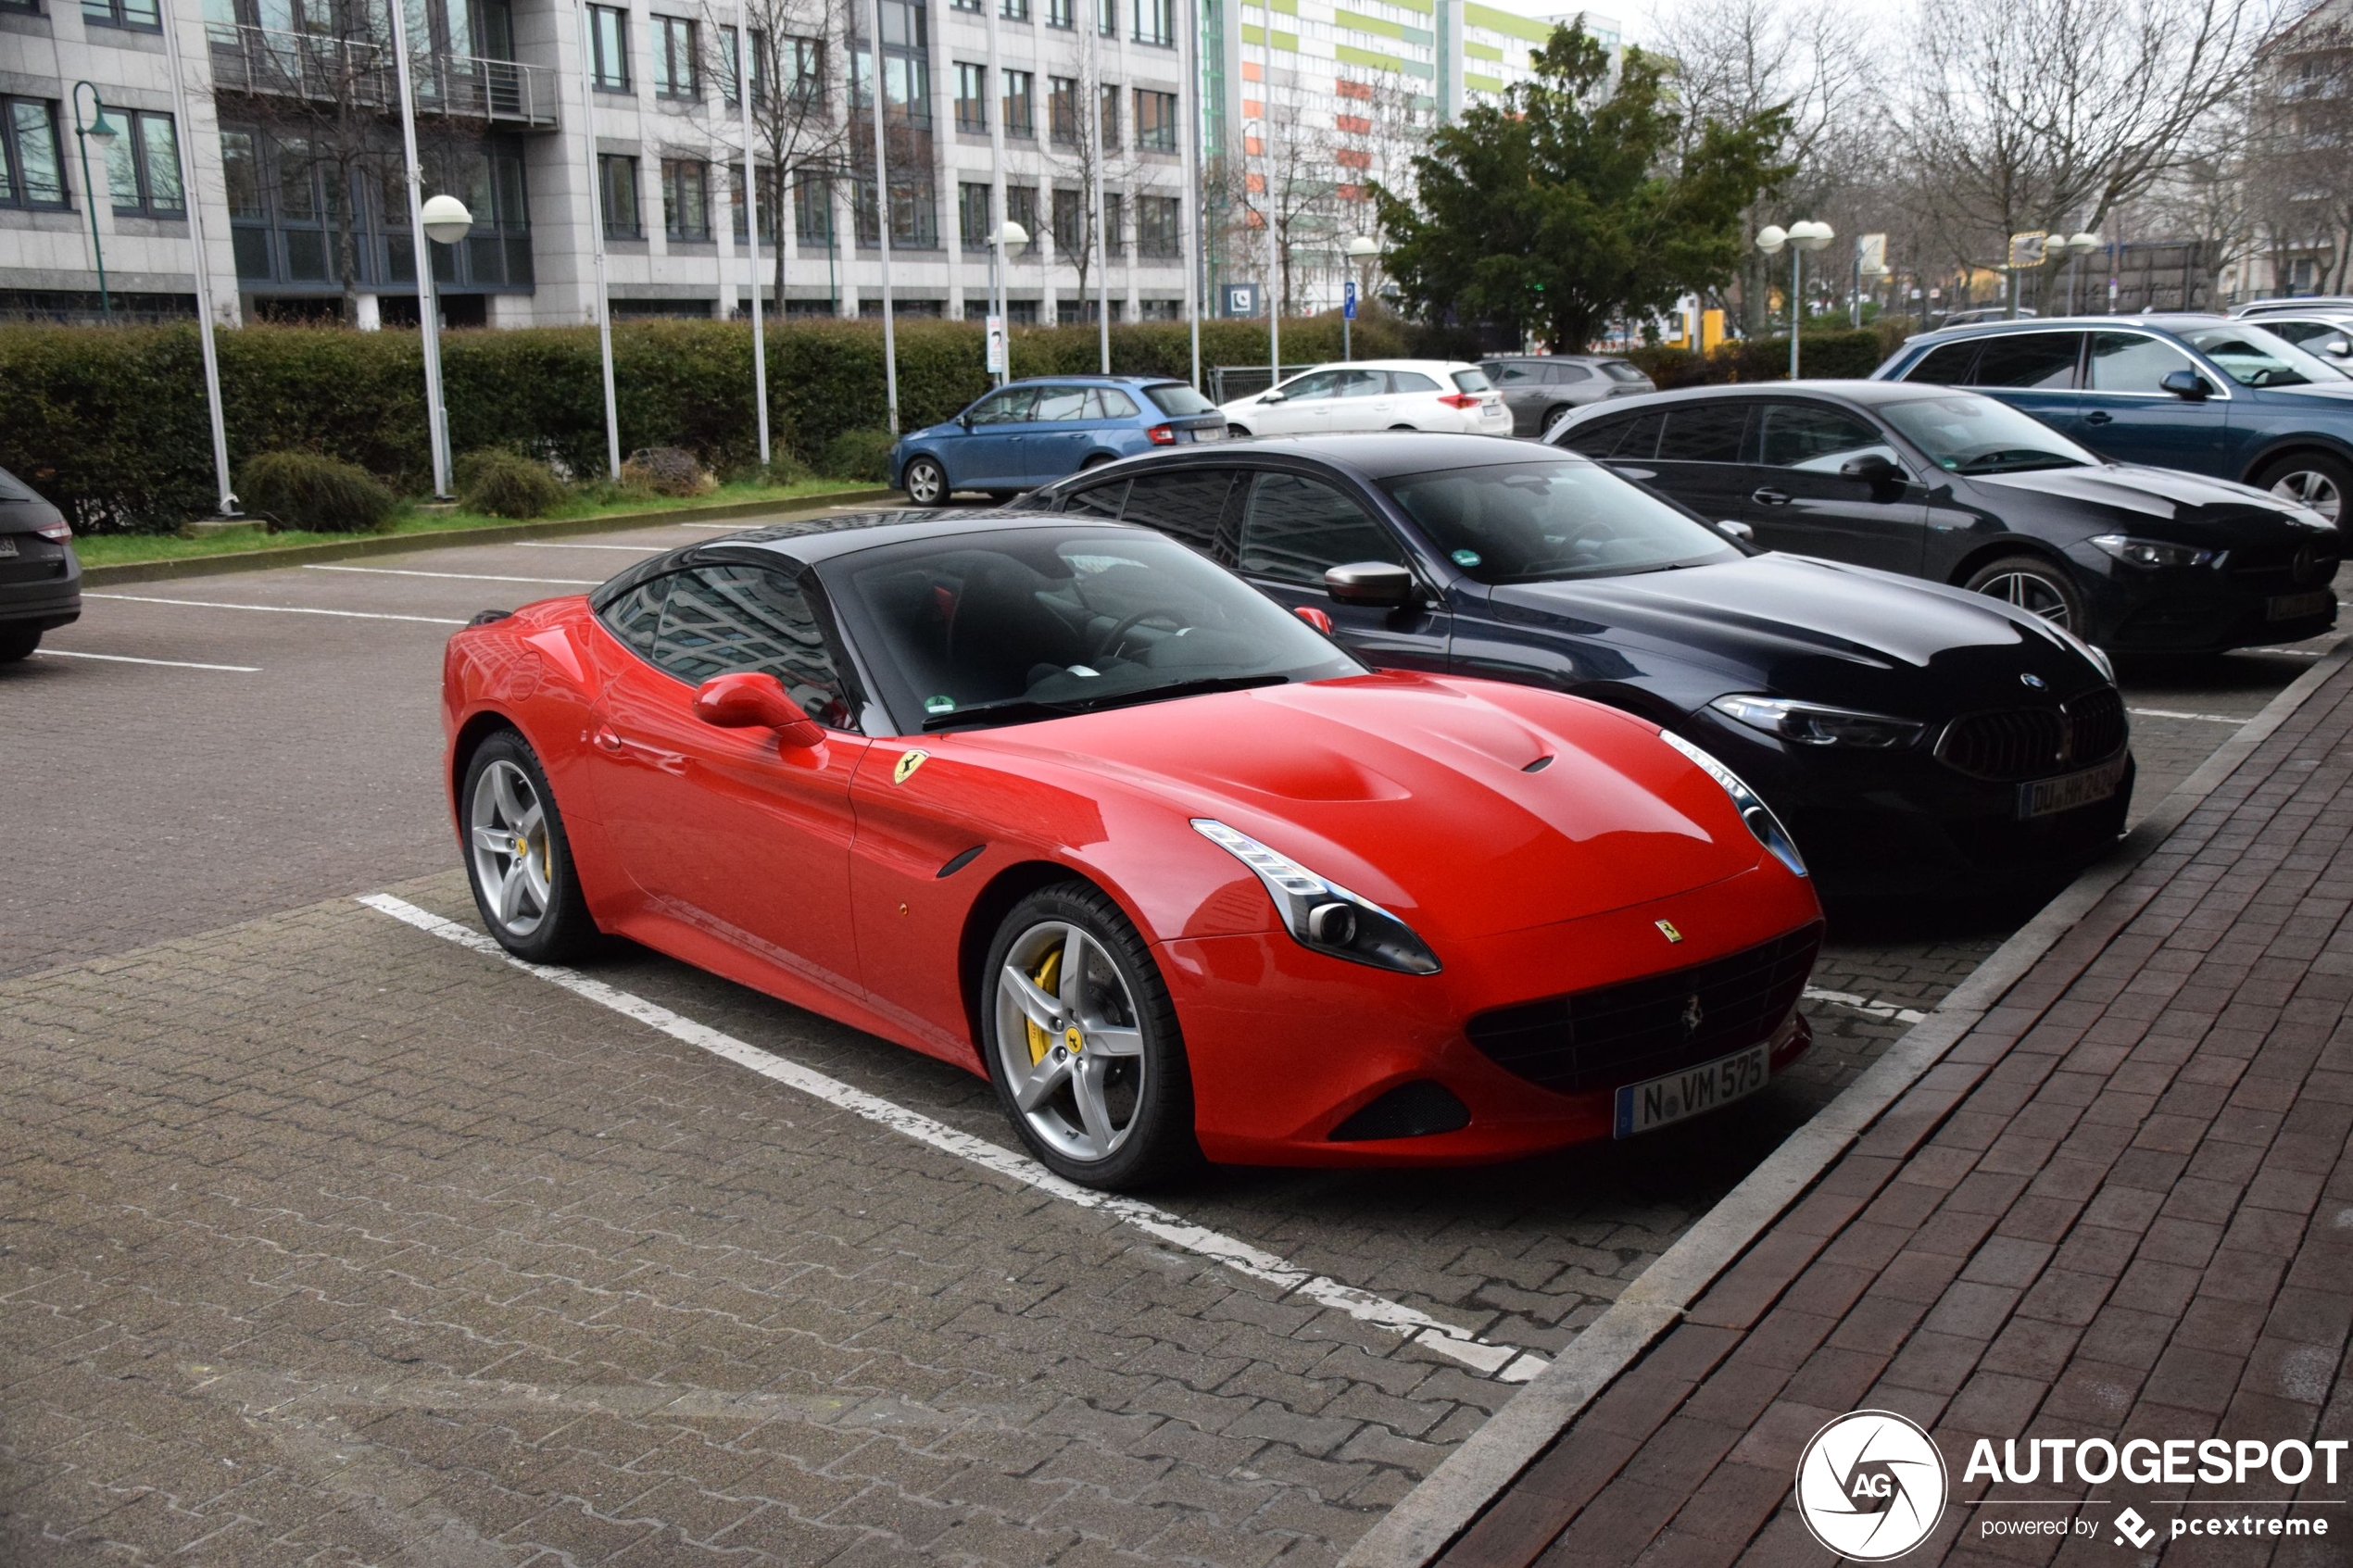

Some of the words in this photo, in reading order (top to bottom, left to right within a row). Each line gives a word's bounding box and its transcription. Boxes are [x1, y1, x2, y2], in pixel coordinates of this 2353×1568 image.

[1345, 284, 1354, 306] P
[1643, 1084, 1664, 1124] N
[1680, 1067, 1716, 1112] VM
[1721, 1049, 1763, 1098] 575
